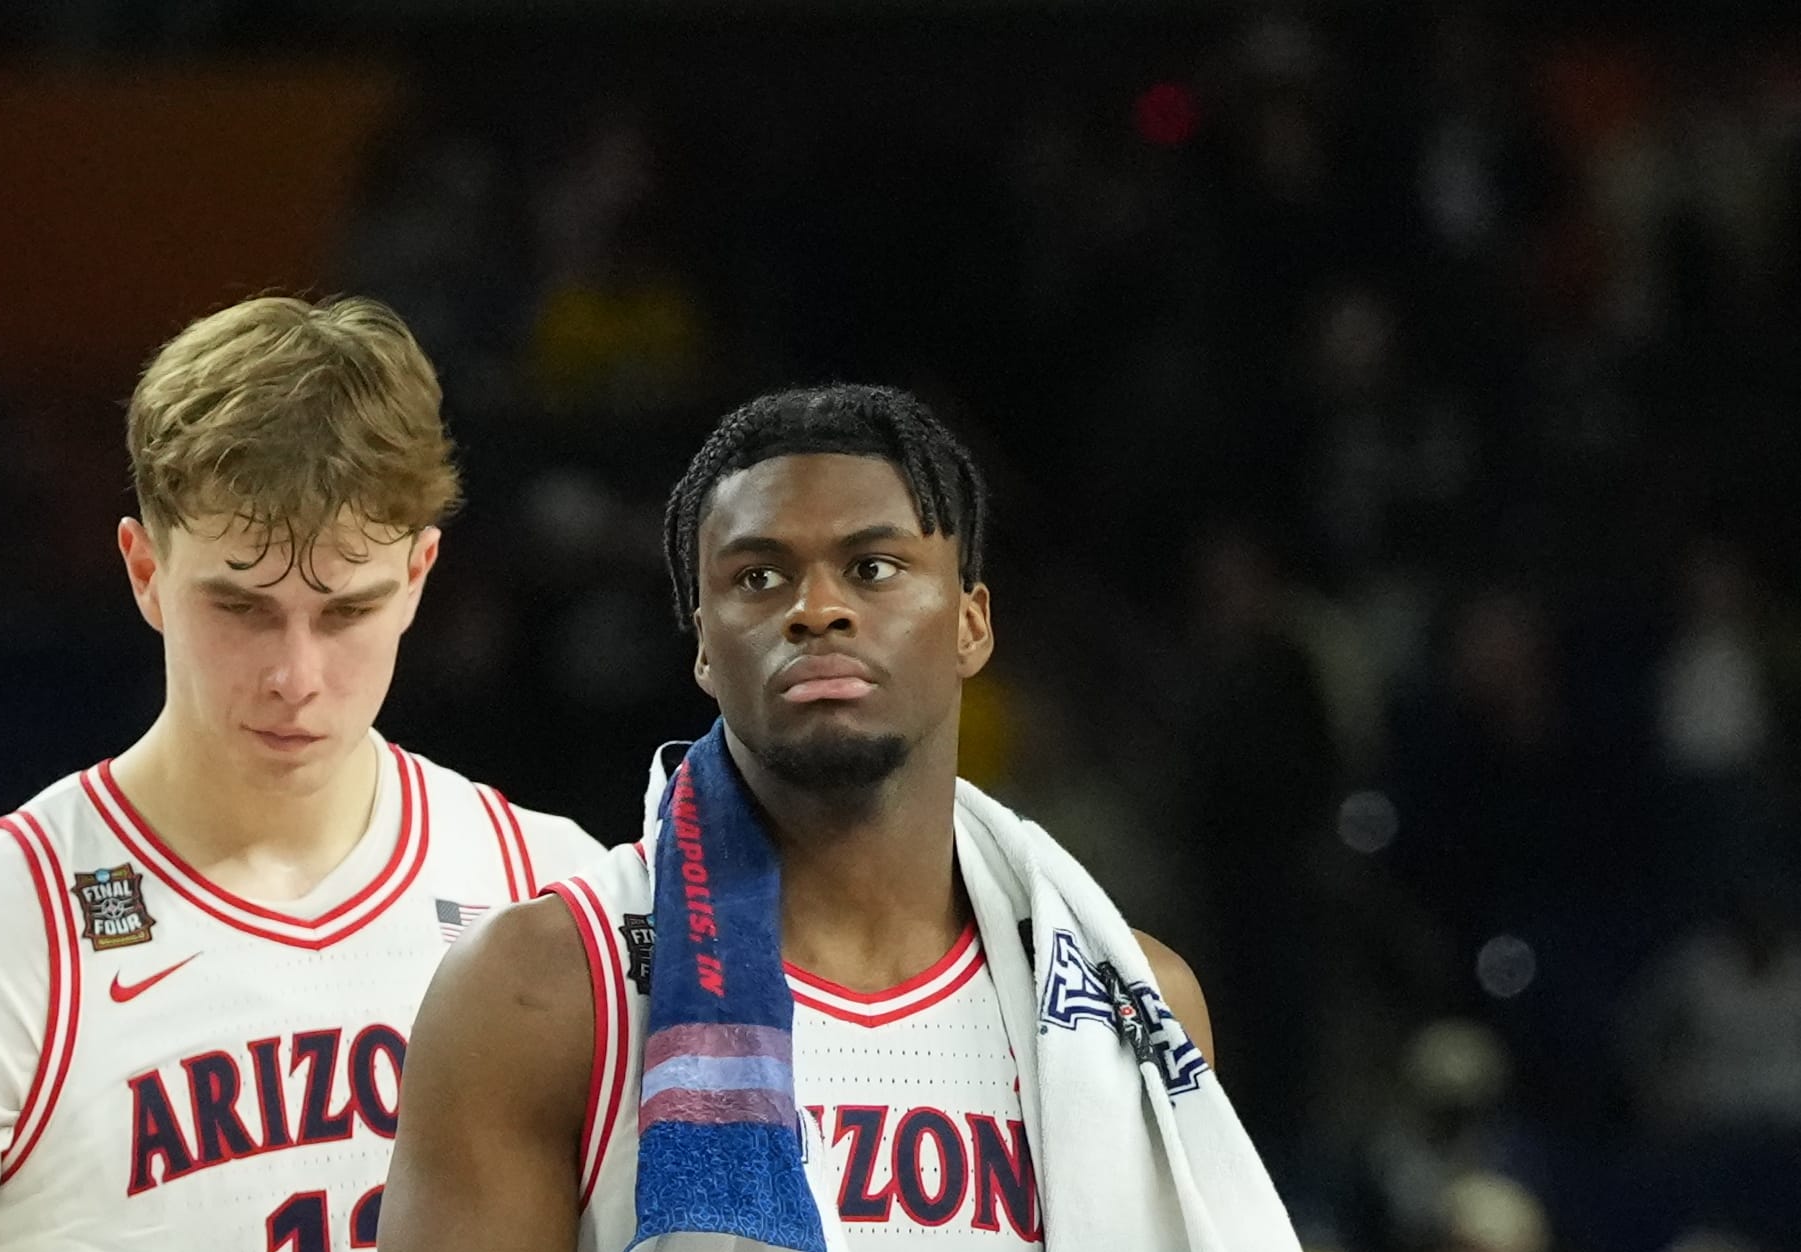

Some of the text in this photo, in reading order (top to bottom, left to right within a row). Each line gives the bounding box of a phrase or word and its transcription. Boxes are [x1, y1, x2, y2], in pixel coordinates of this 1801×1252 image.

[82, 879, 133, 904] FINAL
[94, 913, 142, 935] FOUR
[127, 1023, 408, 1198] ARIZO
[806, 1104, 1044, 1243] ZON
